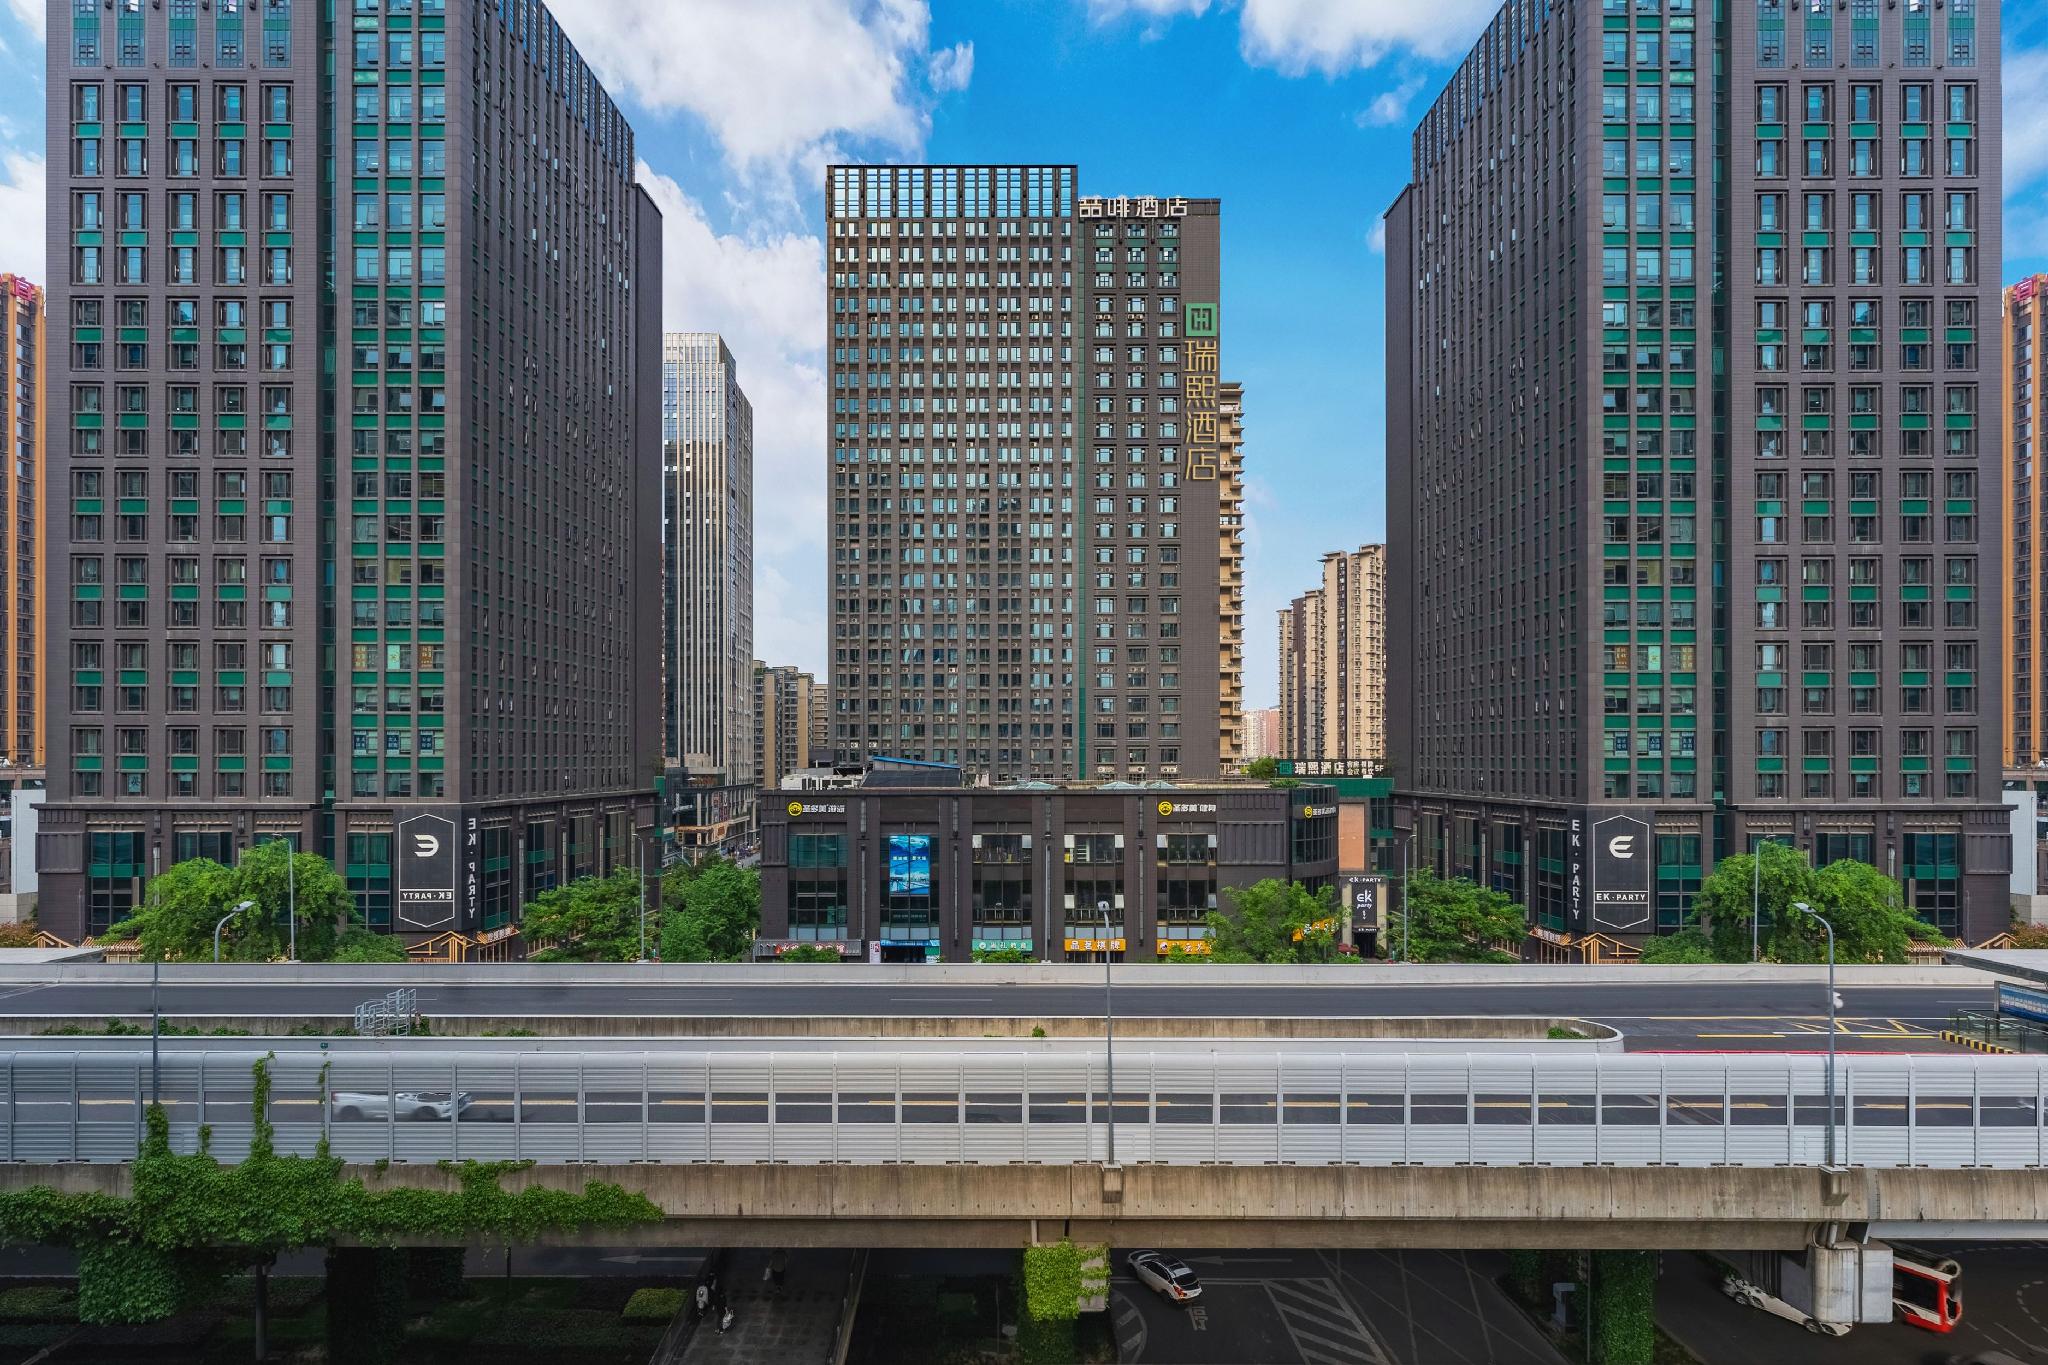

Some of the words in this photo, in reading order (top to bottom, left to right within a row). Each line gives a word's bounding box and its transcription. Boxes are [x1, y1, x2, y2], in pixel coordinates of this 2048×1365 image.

[1185, 340, 1217, 480] 瑞熙酒店
[1295, 761, 1344, 775] 瑞熙酒店
